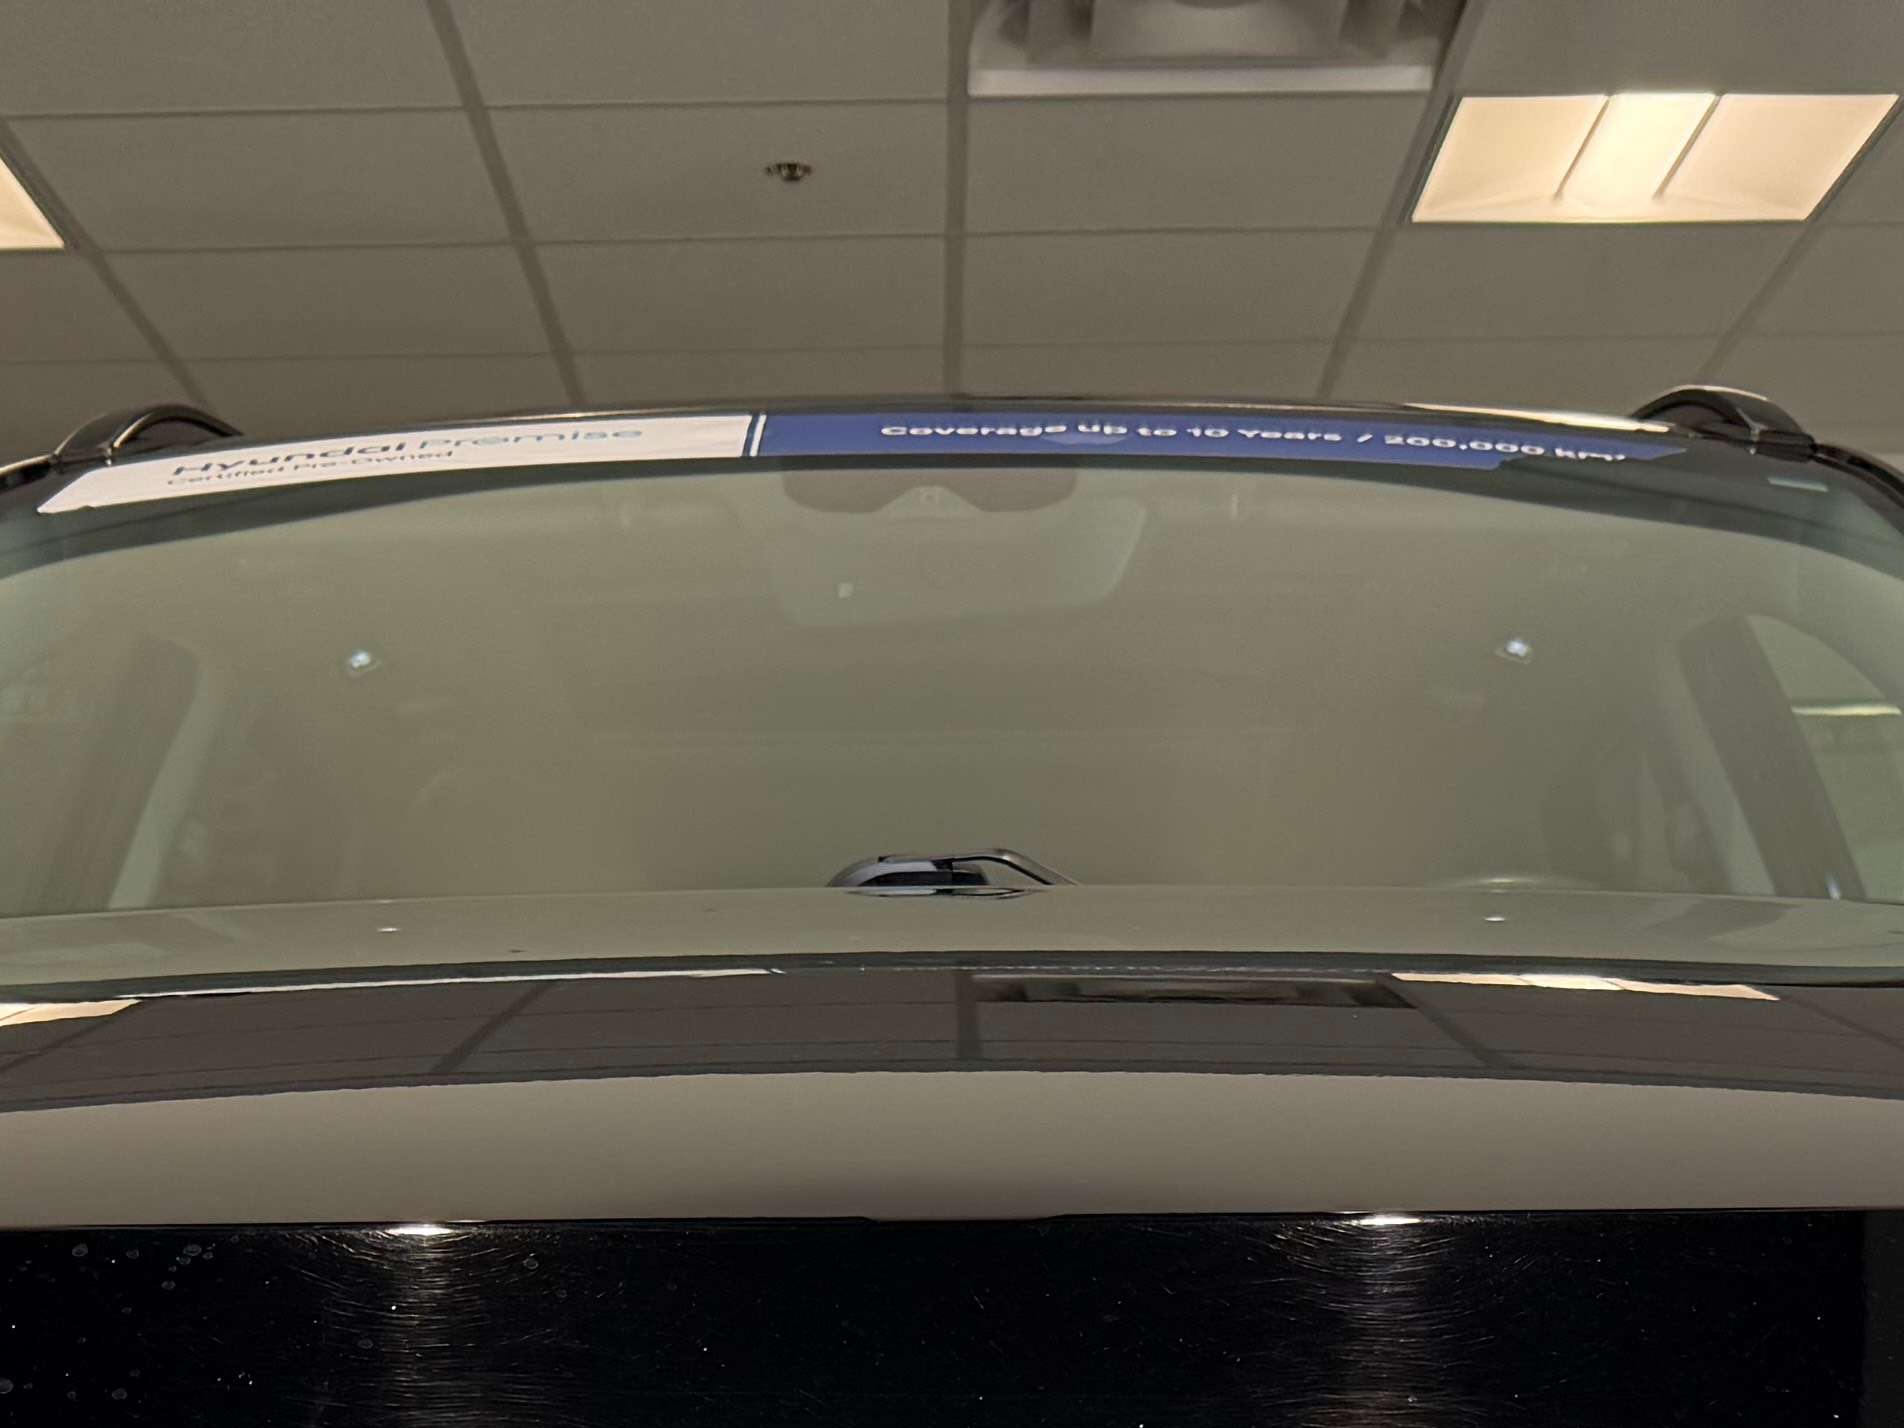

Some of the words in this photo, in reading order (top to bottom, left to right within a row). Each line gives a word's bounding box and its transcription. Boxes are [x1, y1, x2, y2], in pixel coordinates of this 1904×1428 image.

[172, 441, 407, 477] Hyundai
[418, 430, 643, 451] Promise
[879, 424, 1068, 438] Coverage
[1136, 426, 1178, 438] to
[1185, 427, 1231, 439] 10
[1236, 428, 1343, 442] Years
[1356, 432, 1374, 443] /
[1383, 435, 1546, 456] 200,000
[166, 465, 286, 486] Certified
[293, 450, 454, 472] Pre-Owned
